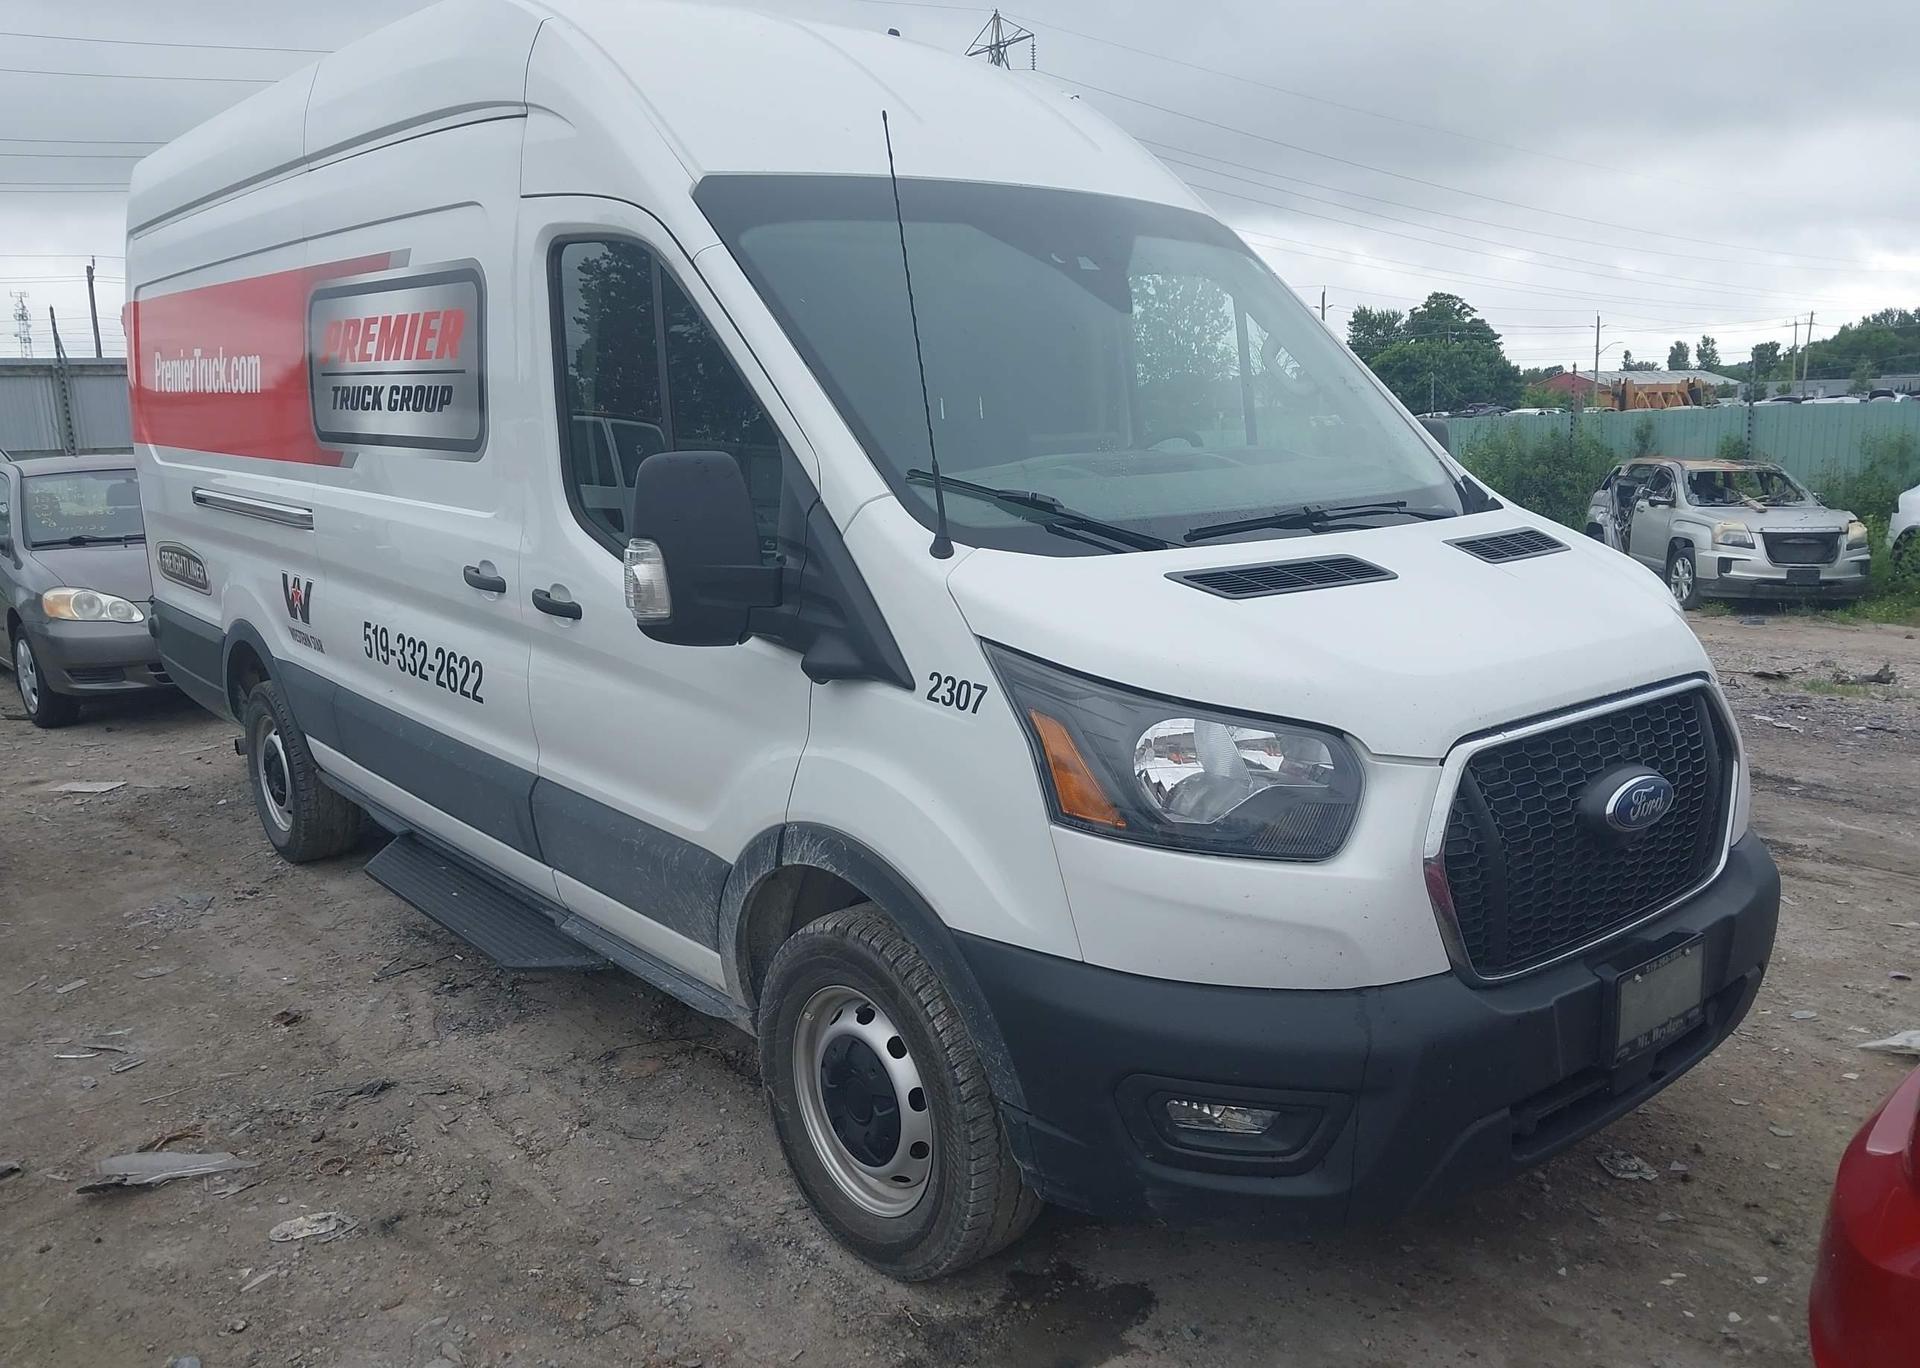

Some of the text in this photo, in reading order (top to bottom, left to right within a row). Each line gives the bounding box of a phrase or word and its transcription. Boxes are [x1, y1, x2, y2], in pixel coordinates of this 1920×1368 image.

[319, 309, 465, 365] PREMIER
[154, 346, 261, 394] PremierTruck.com
[331, 385, 453, 413] TRUCK GROUP
[161, 551, 206, 585] FREIGHTLINER
[363, 621, 484, 704] 519-332-2622
[926, 671, 988, 714] 2307
[1630, 785, 1665, 821] Ford
